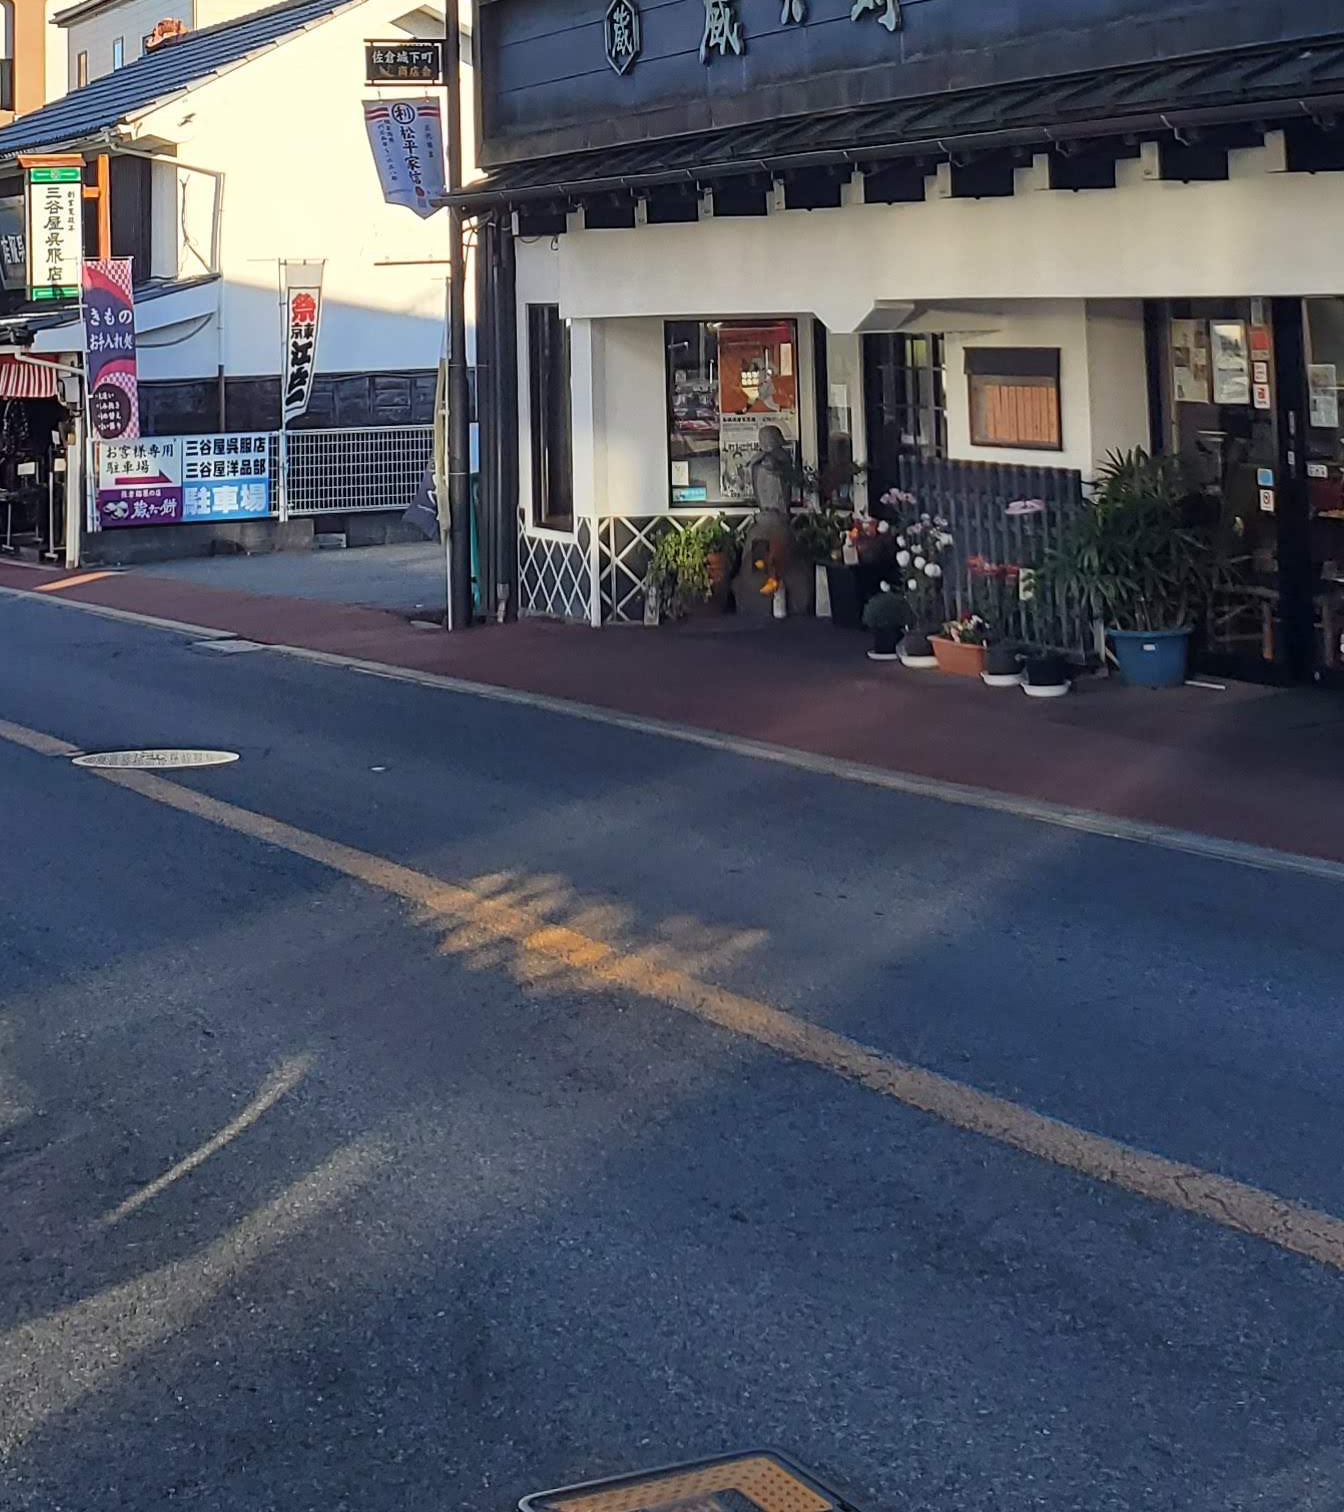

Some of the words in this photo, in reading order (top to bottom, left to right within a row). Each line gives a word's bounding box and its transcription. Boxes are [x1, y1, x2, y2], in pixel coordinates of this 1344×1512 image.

[372, 51, 433, 64] 佐倉城下町
[398, 66, 432, 77] 商店会
[400, 125, 422, 185] 松平家信
[44, 187, 64, 281] 三谷屋呉服店
[90, 308, 132, 326] きもの
[291, 293, 316, 322] 祭
[90, 333, 133, 352] お手入れ処
[106, 443, 174, 459] お客様専用
[186, 438, 266, 457] 三谷屋呉服店
[106, 460, 150, 475] 駐車場
[186, 458, 266, 478] 三谷屋洋品部
[185, 483, 266, 515] 駐車場
